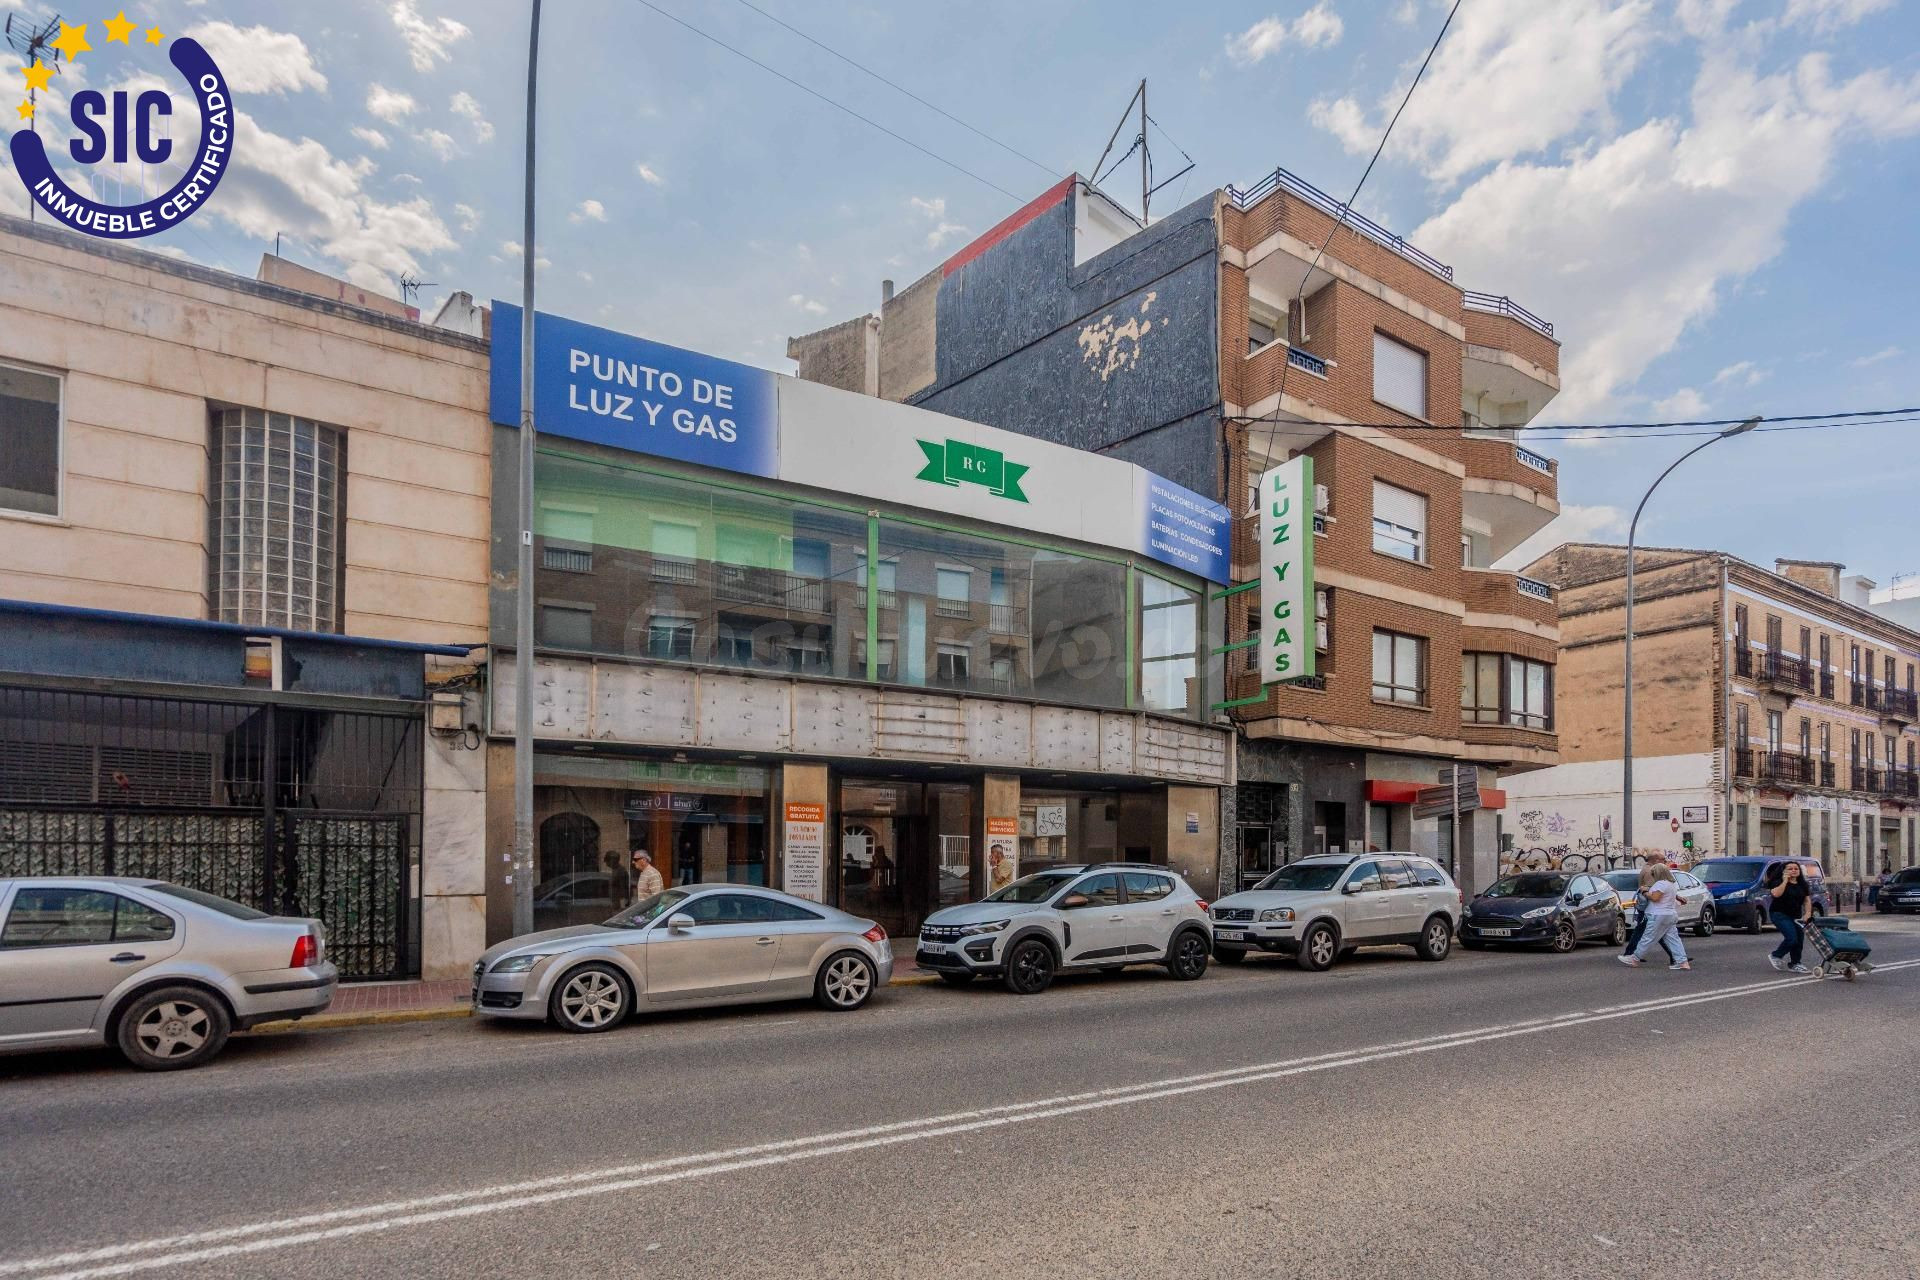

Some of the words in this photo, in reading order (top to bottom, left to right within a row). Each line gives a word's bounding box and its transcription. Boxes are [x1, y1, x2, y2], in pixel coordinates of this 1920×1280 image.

[569, 348, 683, 397] PUNTO
[693, 378, 733, 410] DE
[569, 384, 634, 422] LUZ
[642, 399, 664, 426] Y
[672, 408, 737, 443] GAS
[1151, 484, 1194, 511] INSTALACIONES
[1151, 502, 1174, 518] PLACAS
[1173, 512, 1216, 537] FOTOVOLTAICAS
[1272, 474, 1291, 545] LUZ
[1187, 553, 1199, 564] LED
[1273, 561, 1290, 582] Y
[1273, 600, 1292, 672] GAS
